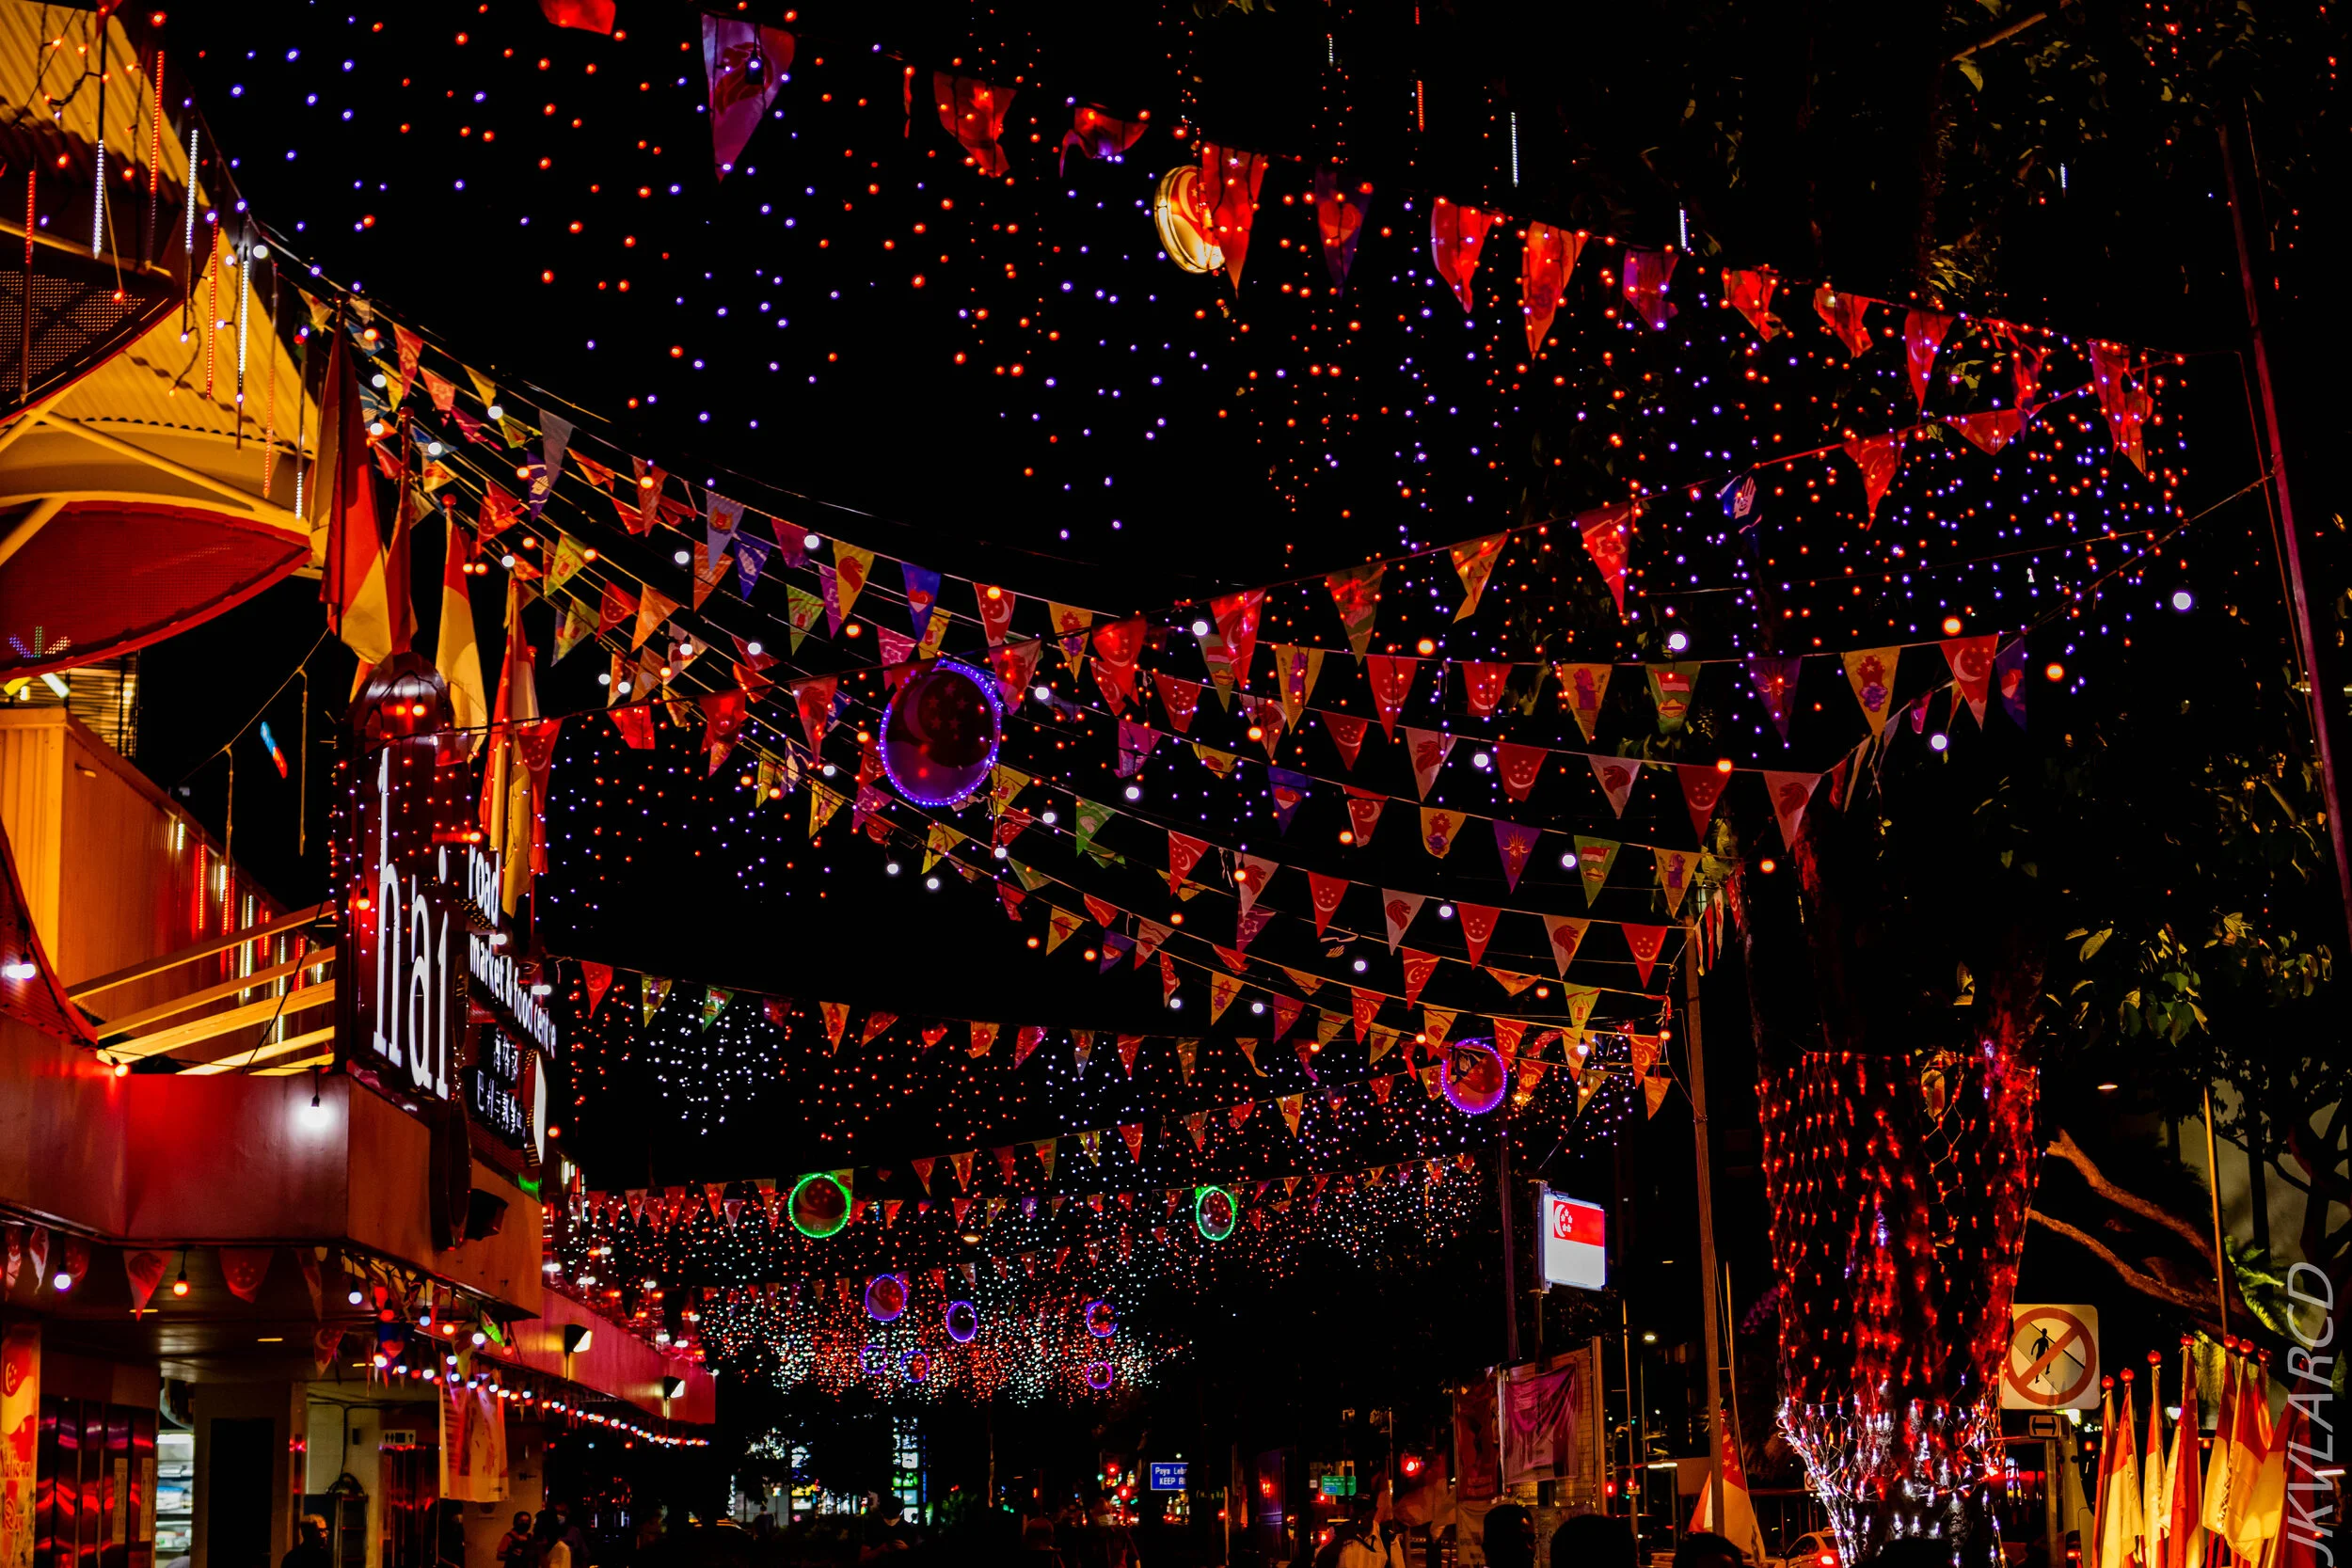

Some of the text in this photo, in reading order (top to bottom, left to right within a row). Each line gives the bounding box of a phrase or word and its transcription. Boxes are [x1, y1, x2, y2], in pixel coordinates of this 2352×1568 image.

[469, 844, 501, 928] road
[469, 932, 504, 1003] market
[505, 956, 513, 1009] &
[514, 967, 533, 1034] food
[1155, 1466, 1170, 1477] Paya
[1159, 1477, 1176, 1485] KEEP
